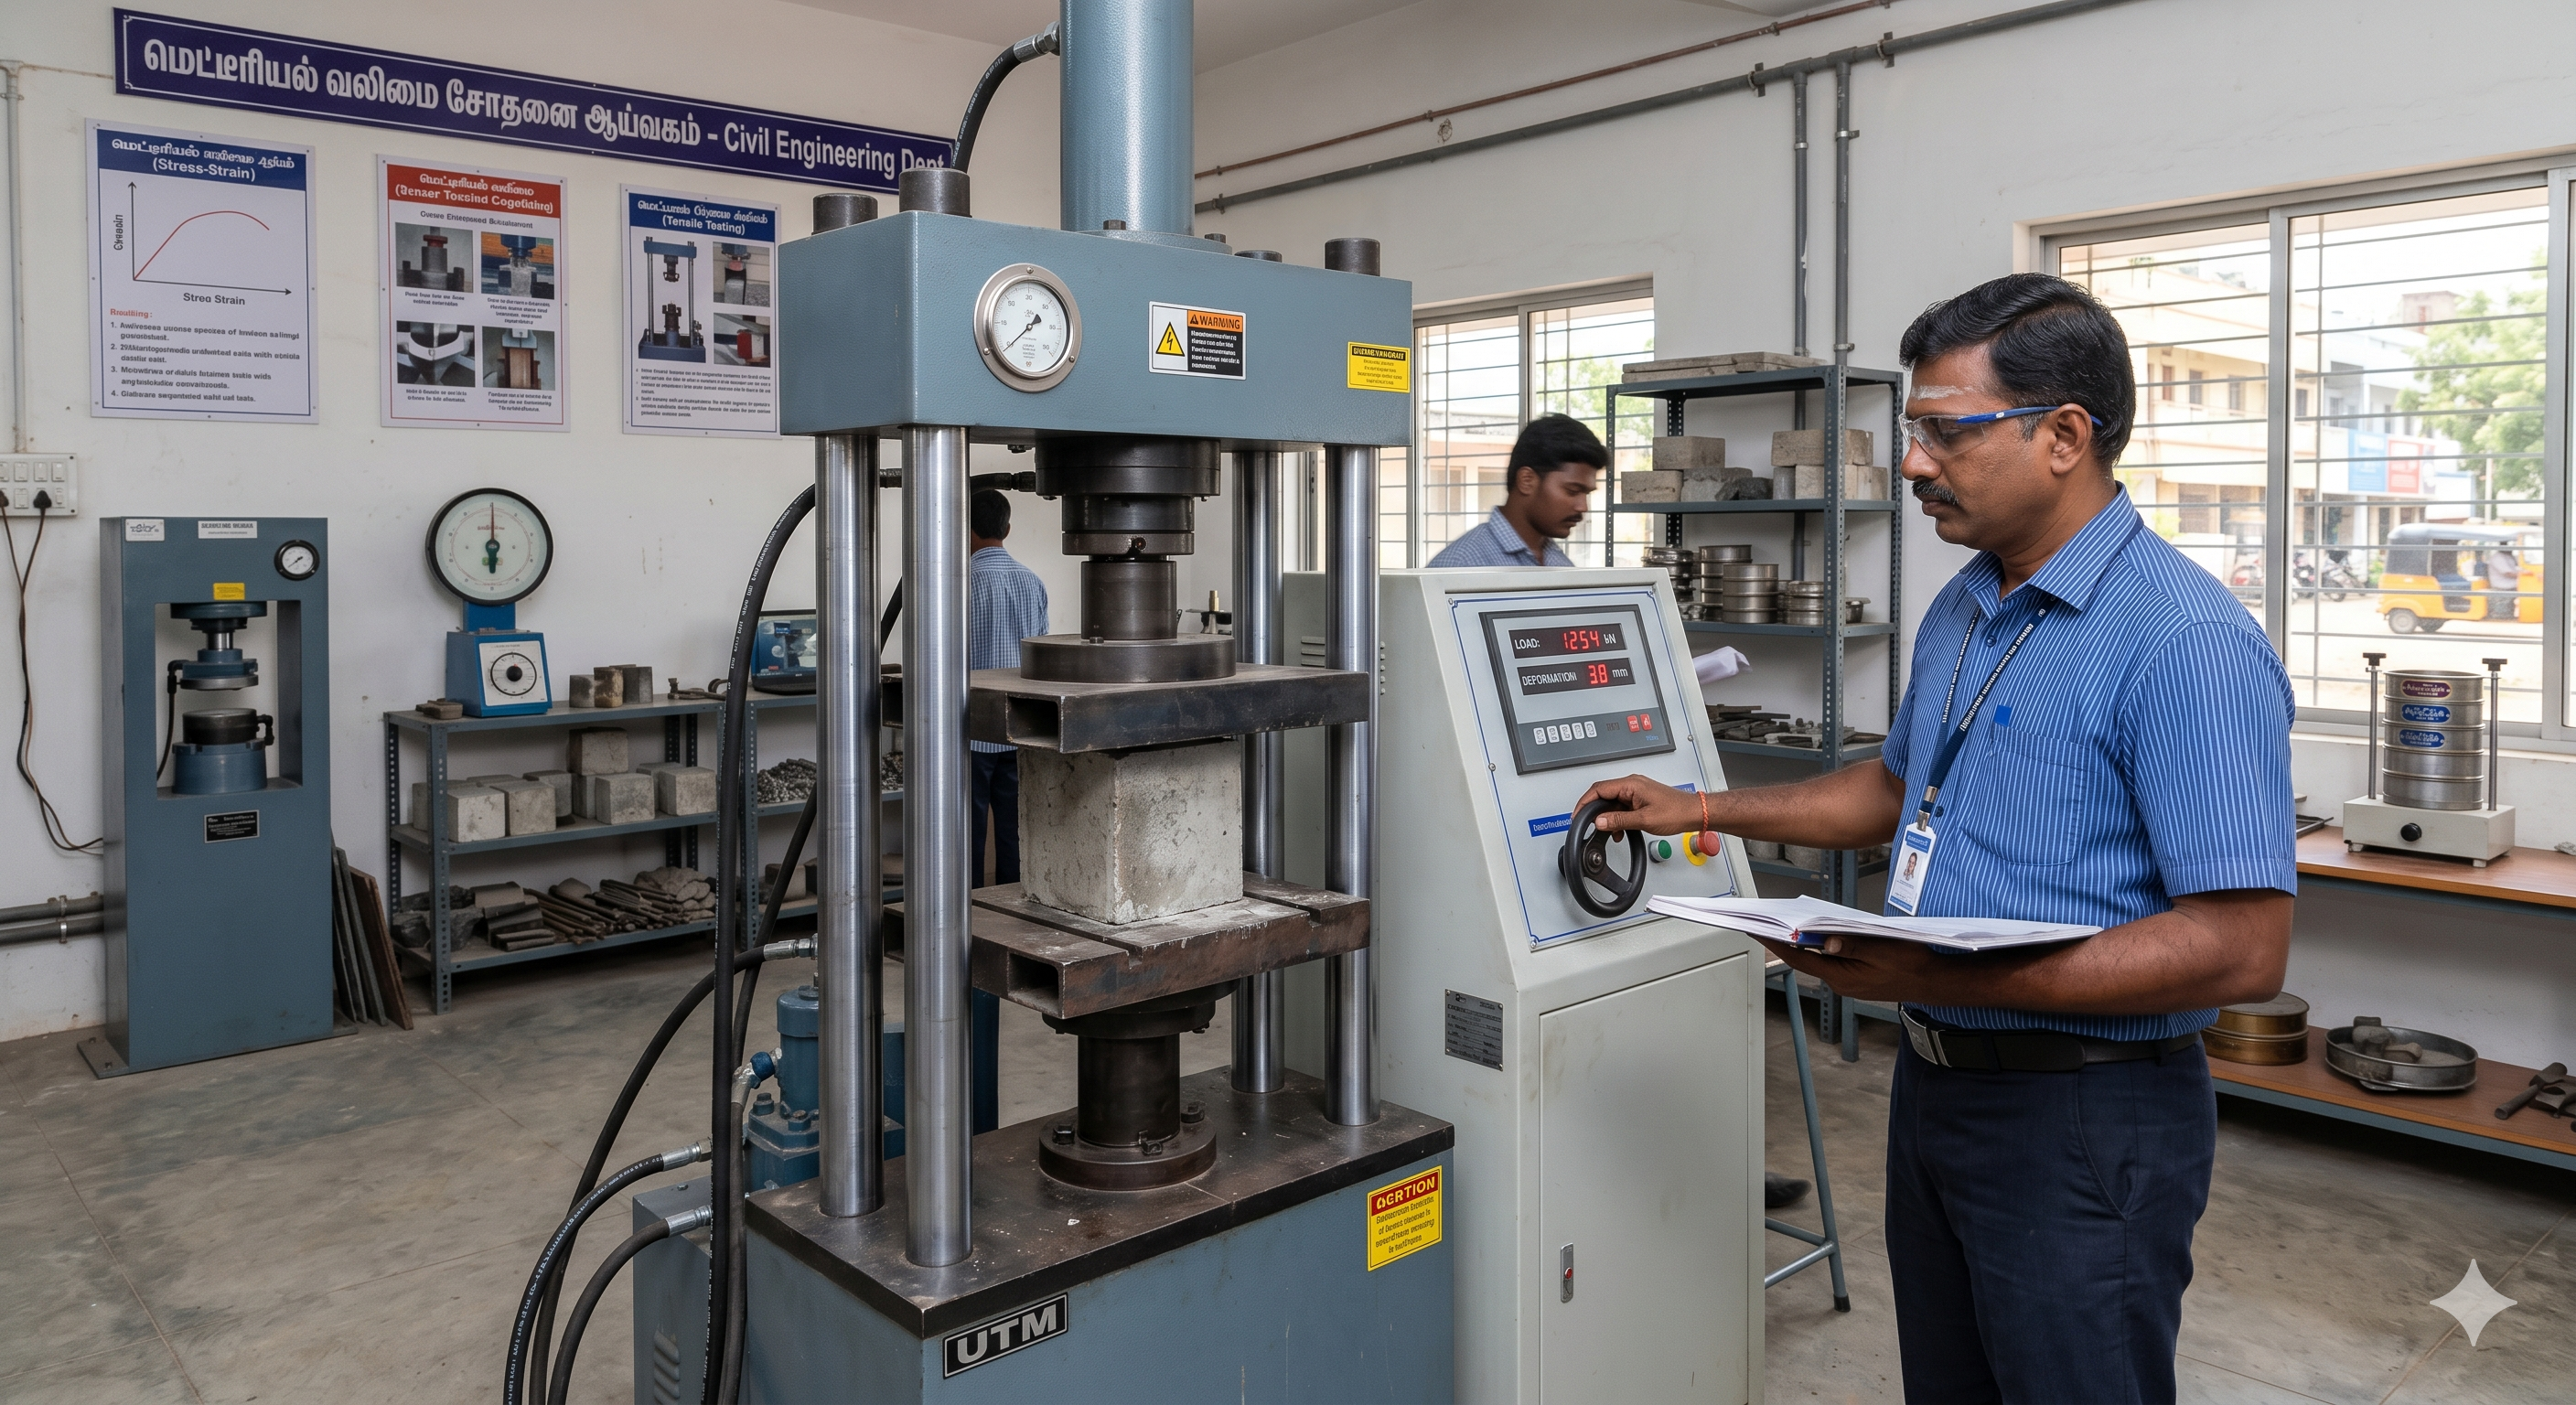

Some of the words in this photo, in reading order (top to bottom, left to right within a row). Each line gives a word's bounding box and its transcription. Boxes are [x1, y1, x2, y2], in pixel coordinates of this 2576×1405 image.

[144, 38, 319, 92] மெட்டீரியல்
[326, 65, 439, 110] வலிமை
[445, 78, 578, 131] சோதனை
[585, 102, 702, 146] ஆய்வகம்
[724, 122, 770, 156] Civil
[776, 129, 896, 180] Engineering
[153, 156, 256, 182] (Stress-Strain)
[214, 295, 245, 306] Strain
[1514, 638, 1540, 649] LOAD:
[1562, 630, 1600, 650] 1254
[1612, 668, 1628, 678] mm
[957, 1303, 1057, 1364] UTM
